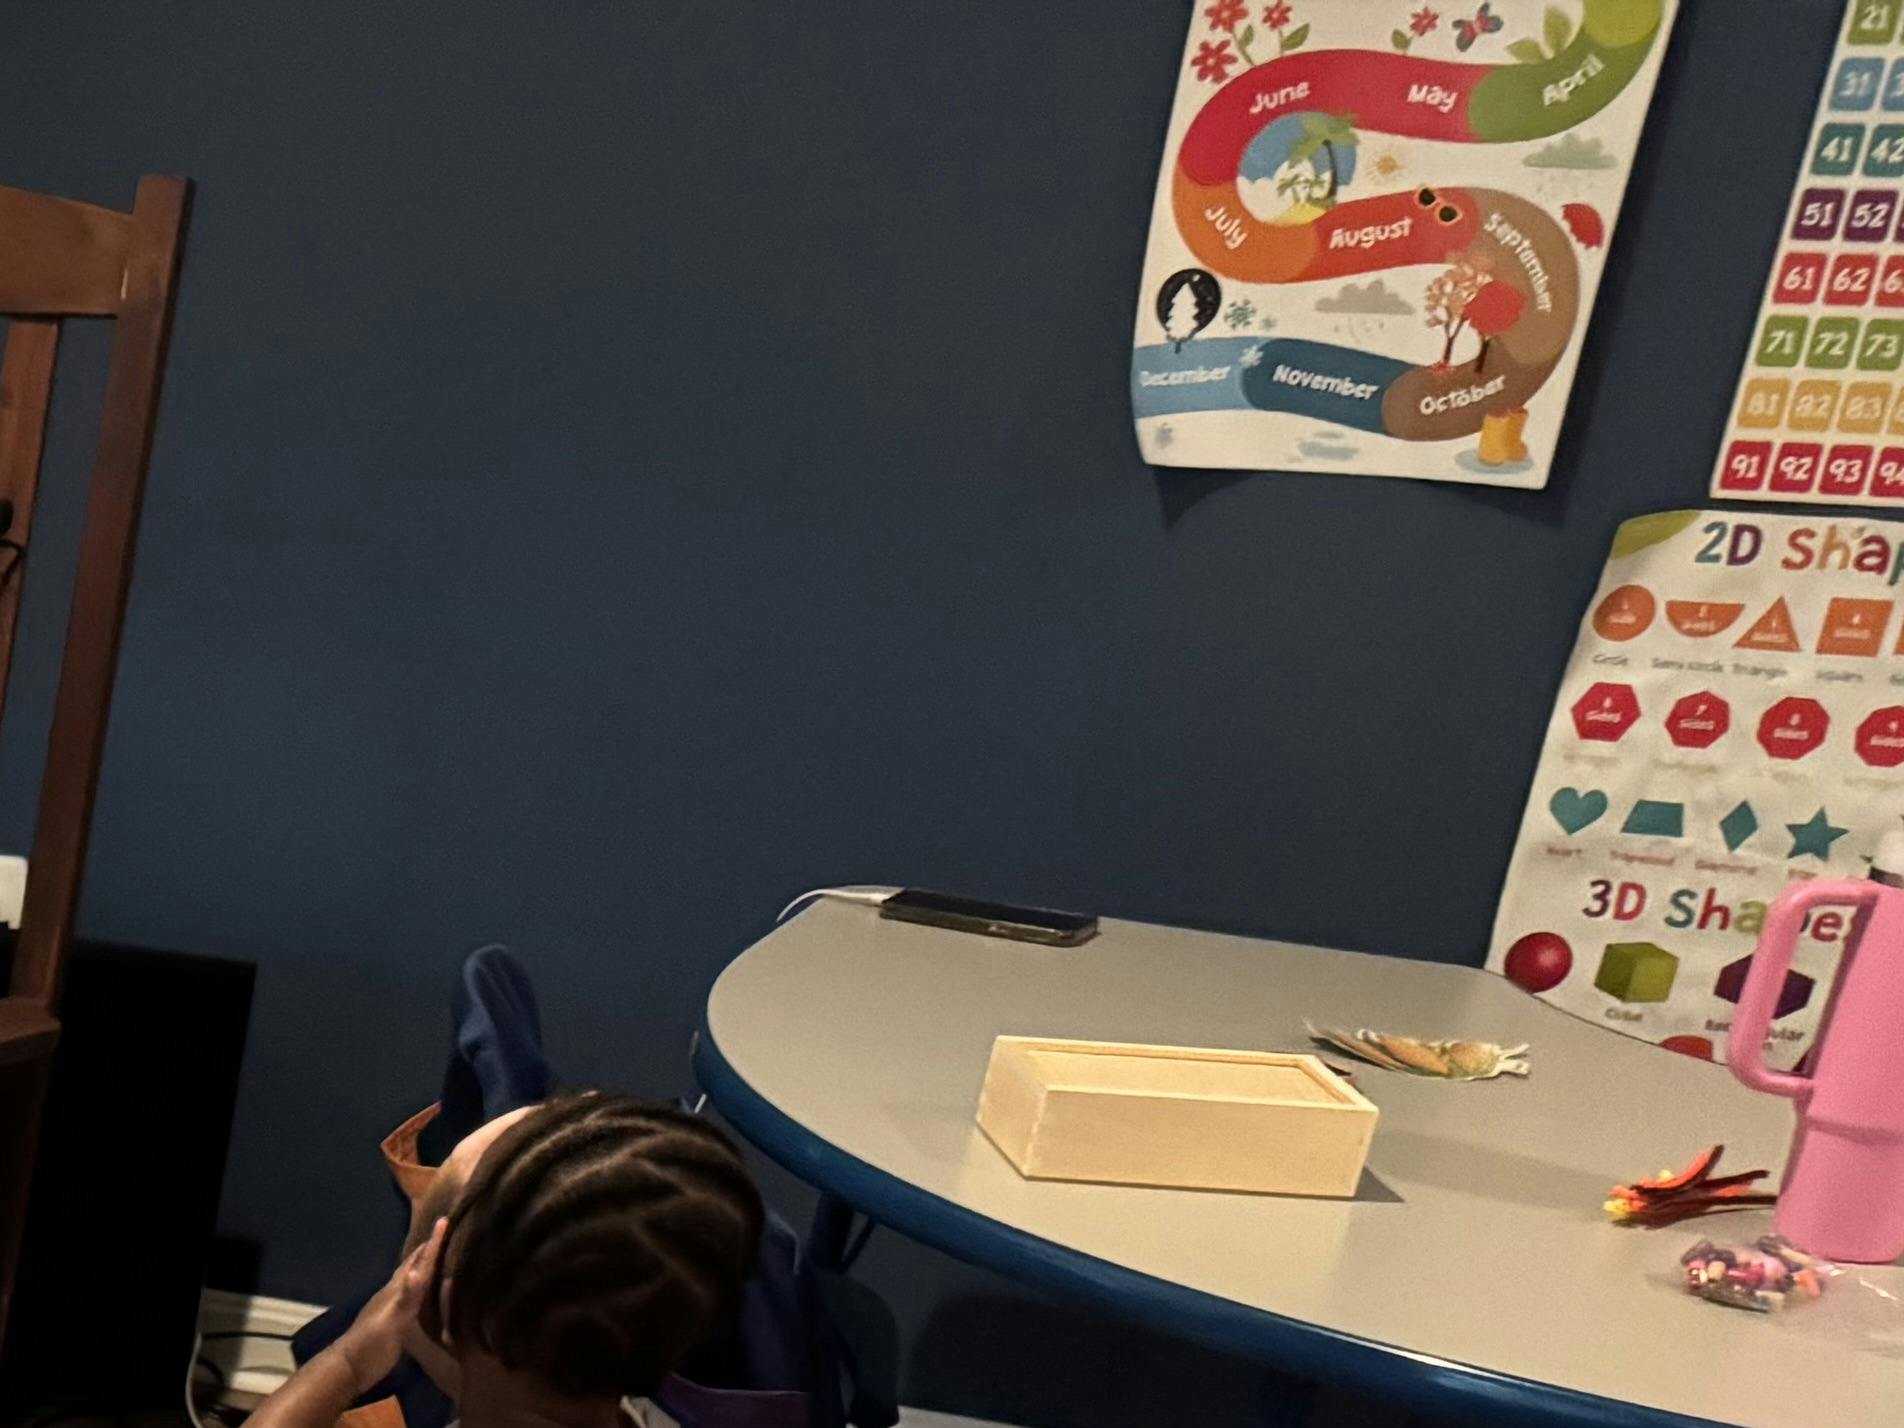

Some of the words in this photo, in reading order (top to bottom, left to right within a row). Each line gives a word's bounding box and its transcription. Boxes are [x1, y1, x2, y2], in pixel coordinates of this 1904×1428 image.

[1249, 81, 1311, 115] June
[1407, 83, 1457, 113] May
[1541, 56, 1604, 107] April
[1820, 137, 1854, 162] 41
[1204, 206, 1247, 250] July
[1801, 202, 1833, 228] 51
[1851, 202, 1888, 229] 52
[1330, 218, 1412, 250] August
[1784, 265, 1817, 292] 61
[1833, 265, 1868, 292] 62
[1765, 331, 1796, 358] 71
[1814, 331, 1848, 357] 72
[1866, 332, 1902, 360] 73
[1272, 364, 1379, 400] November
[1419, 373, 1505, 418] October
[1732, 454, 1761, 479] 91
[1780, 456, 1814, 480] 92
[1830, 458, 1863, 483] 93
[1695, 521, 1762, 566] 2D
[1582, 879, 1647, 921] 3D
